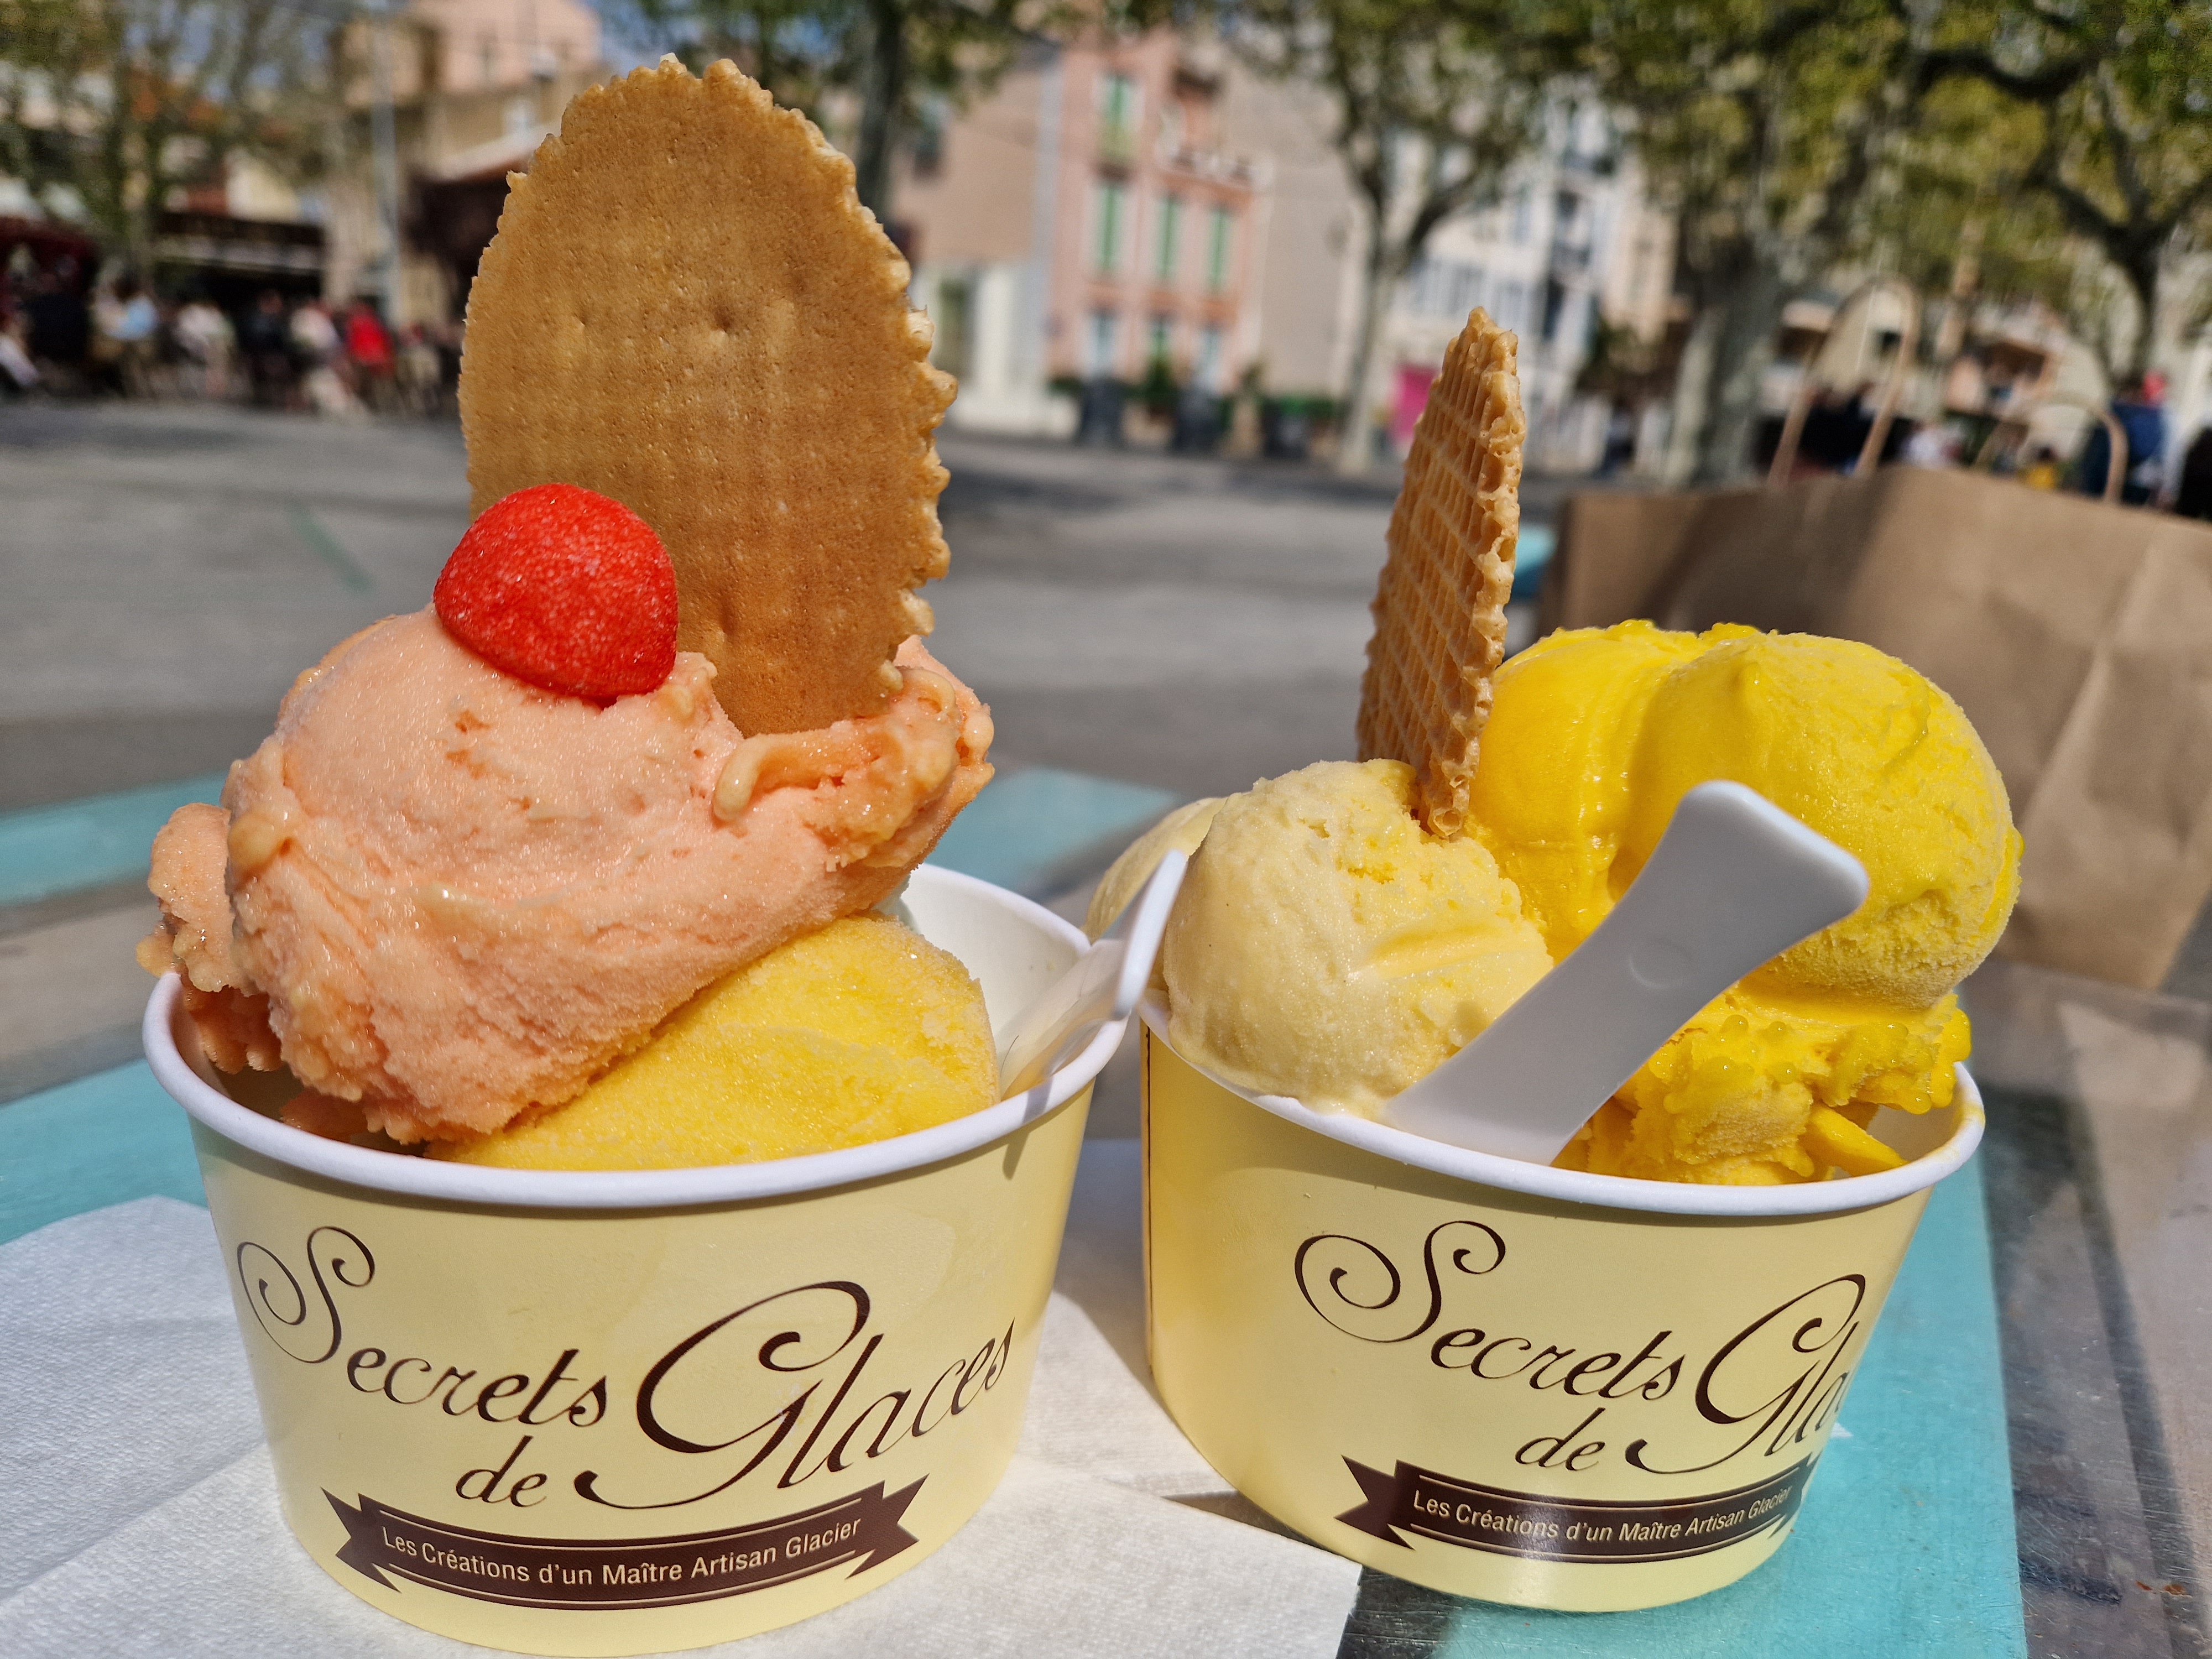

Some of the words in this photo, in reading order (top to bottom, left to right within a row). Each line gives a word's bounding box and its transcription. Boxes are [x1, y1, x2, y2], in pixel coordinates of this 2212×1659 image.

[237, 1225, 607, 1427] Secrets
[1295, 1220, 1686, 1400] Secrets
[455, 1435, 548, 1507] de
[573, 1281, 1015, 1510] Glaces
[1514, 1407, 1606, 1471] de
[382, 1526, 418, 1556] Les
[422, 1545, 530, 1582] Créations
[539, 1565, 593, 1586] d'un
[602, 1562, 682, 1586] Maître
[691, 1546, 776, 1577] Artisan
[785, 1519, 861, 1557] Glacier
[1413, 1489, 1449, 1518] Les
[1455, 1503, 1559, 1538] Créations
[1566, 1524, 1612, 1541] d'un
[1619, 1521, 1681, 1542] Maître
[1684, 1509, 1745, 1537] Artisan
[1747, 1485, 1792, 1519] Glacier
